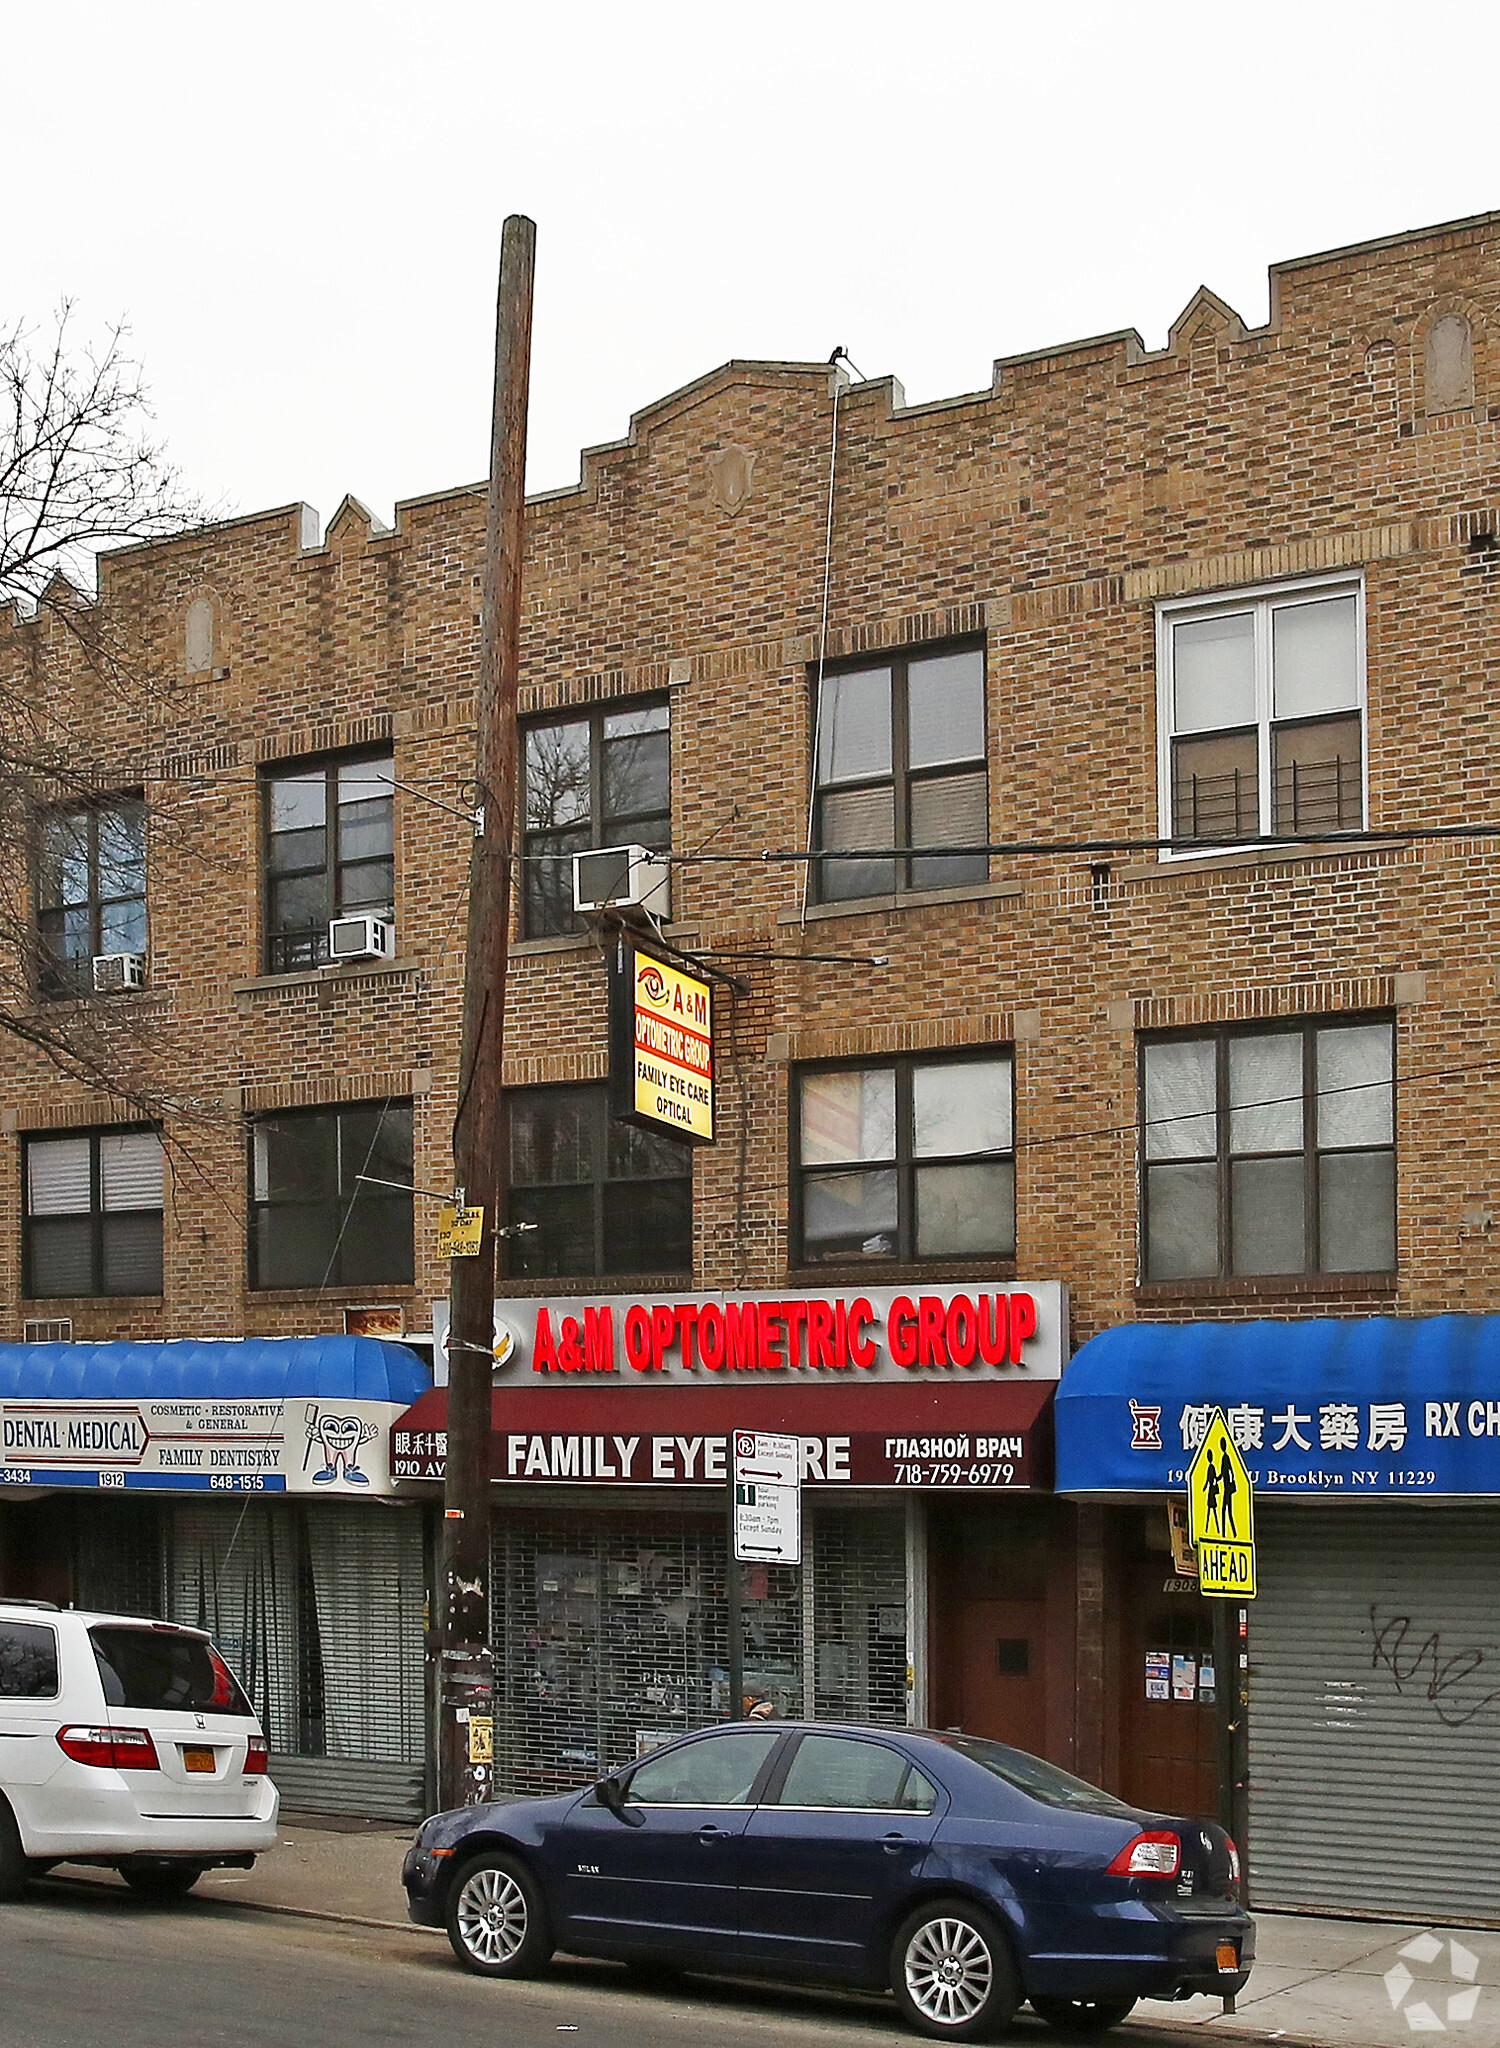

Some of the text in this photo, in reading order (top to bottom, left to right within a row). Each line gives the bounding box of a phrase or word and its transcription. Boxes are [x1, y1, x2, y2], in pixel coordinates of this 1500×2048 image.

[635, 1011, 710, 1072] OPTOMETRIC GROUP
[637, 1061, 709, 1106] FAMILY EYE CARE
[656, 1096, 692, 1125] OPTICAL
[532, 1292, 1038, 1373] A&M OPTOMETRIC GROUP
[150, 1405, 284, 1416] COSMETIC RESTORATIVE
[1425, 1401, 1461, 1437] RX
[186, 1419, 248, 1430] & GENERAL
[3, 1420, 140, 1450] DENTAL MEDICAL
[775, 1451, 793, 1460] Sunday
[885, 1432, 1022, 1459] ГЛАЗНОЙ ВРАЧ
[159, 1449, 280, 1466] FAMILY DENTISTRY
[507, 1434, 851, 1480] FAMILY EYE RE
[394, 1460, 420, 1476] 1910
[893, 1462, 1015, 1486] 718-759-6979
[101, 1473, 124, 1486] 1912
[209, 1475, 264, 1490] 648-1515
[1266, 1471, 1344, 1488] Brooklyn
[1352, 1471, 1379, 1485] NY
[1387, 1471, 1436, 1485] 11229
[739, 1523, 783, 1536] Except Sunday
[1203, 1550, 1248, 1583] AHEAD
[643, 1672, 696, 1687] PRADA
